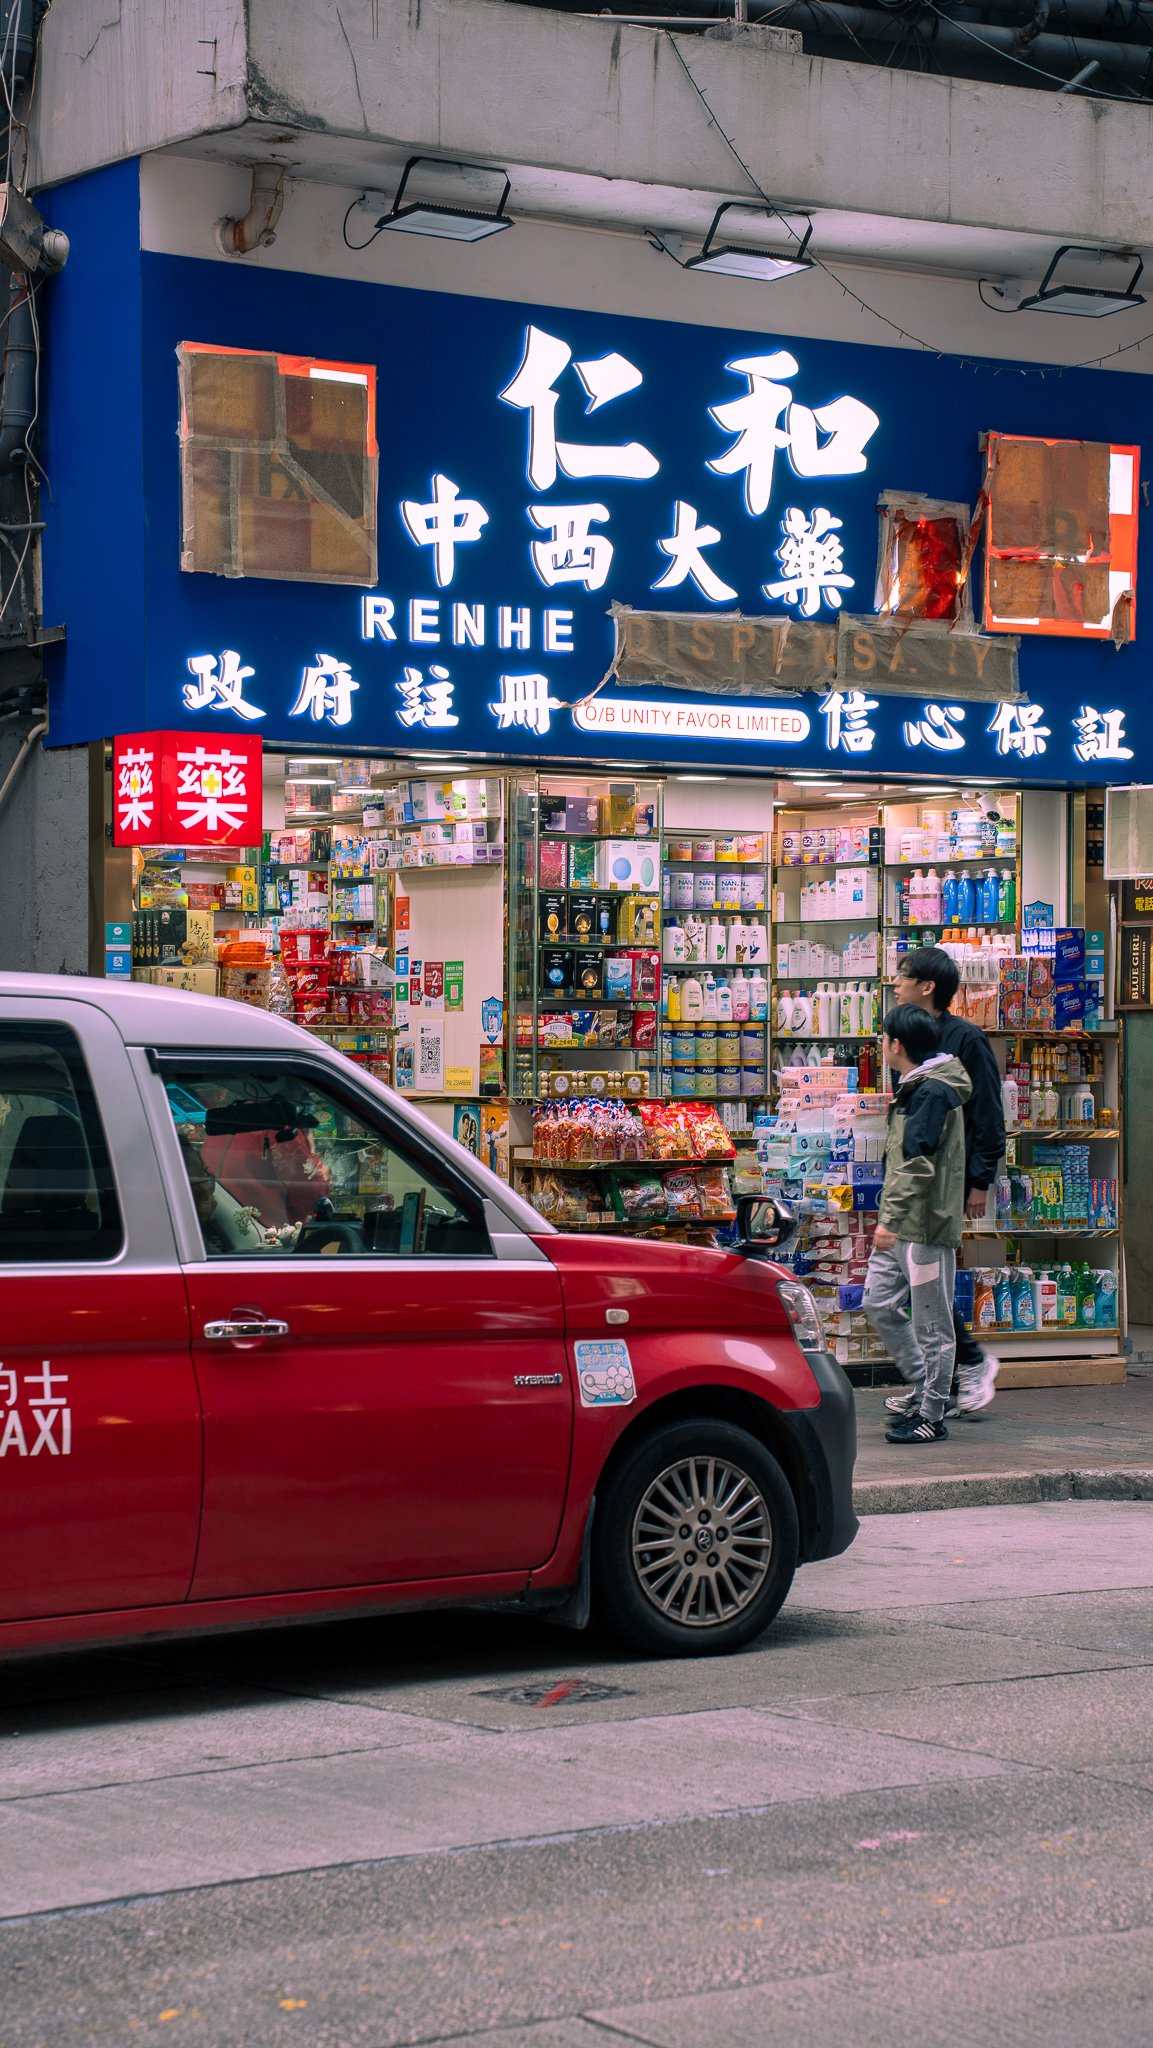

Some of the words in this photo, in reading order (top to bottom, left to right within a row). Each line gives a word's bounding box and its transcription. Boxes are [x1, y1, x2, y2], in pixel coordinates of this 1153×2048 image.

[499, 325, 880, 516] 仁和
[401, 473, 855, 617] 中西大藥
[361, 595, 575, 652] RENHE
[182, 649, 561, 735] 政府註冊
[585, 706, 615, 722] O/B
[621, 708, 671, 727] UNITY
[677, 711, 732, 730] FAVOR
[736, 715, 802, 733] LIMITED
[818, 691, 1135, 762] 信心保証
[118, 747, 154, 831] 藥
[176, 746, 248, 831] 藥
[1131, 934, 1140, 966] GIRL
[1131, 968, 1140, 1000] BLUE
[513, 1374, 556, 1386] HYBRID
[0, 1408, 72, 1457] AXI
